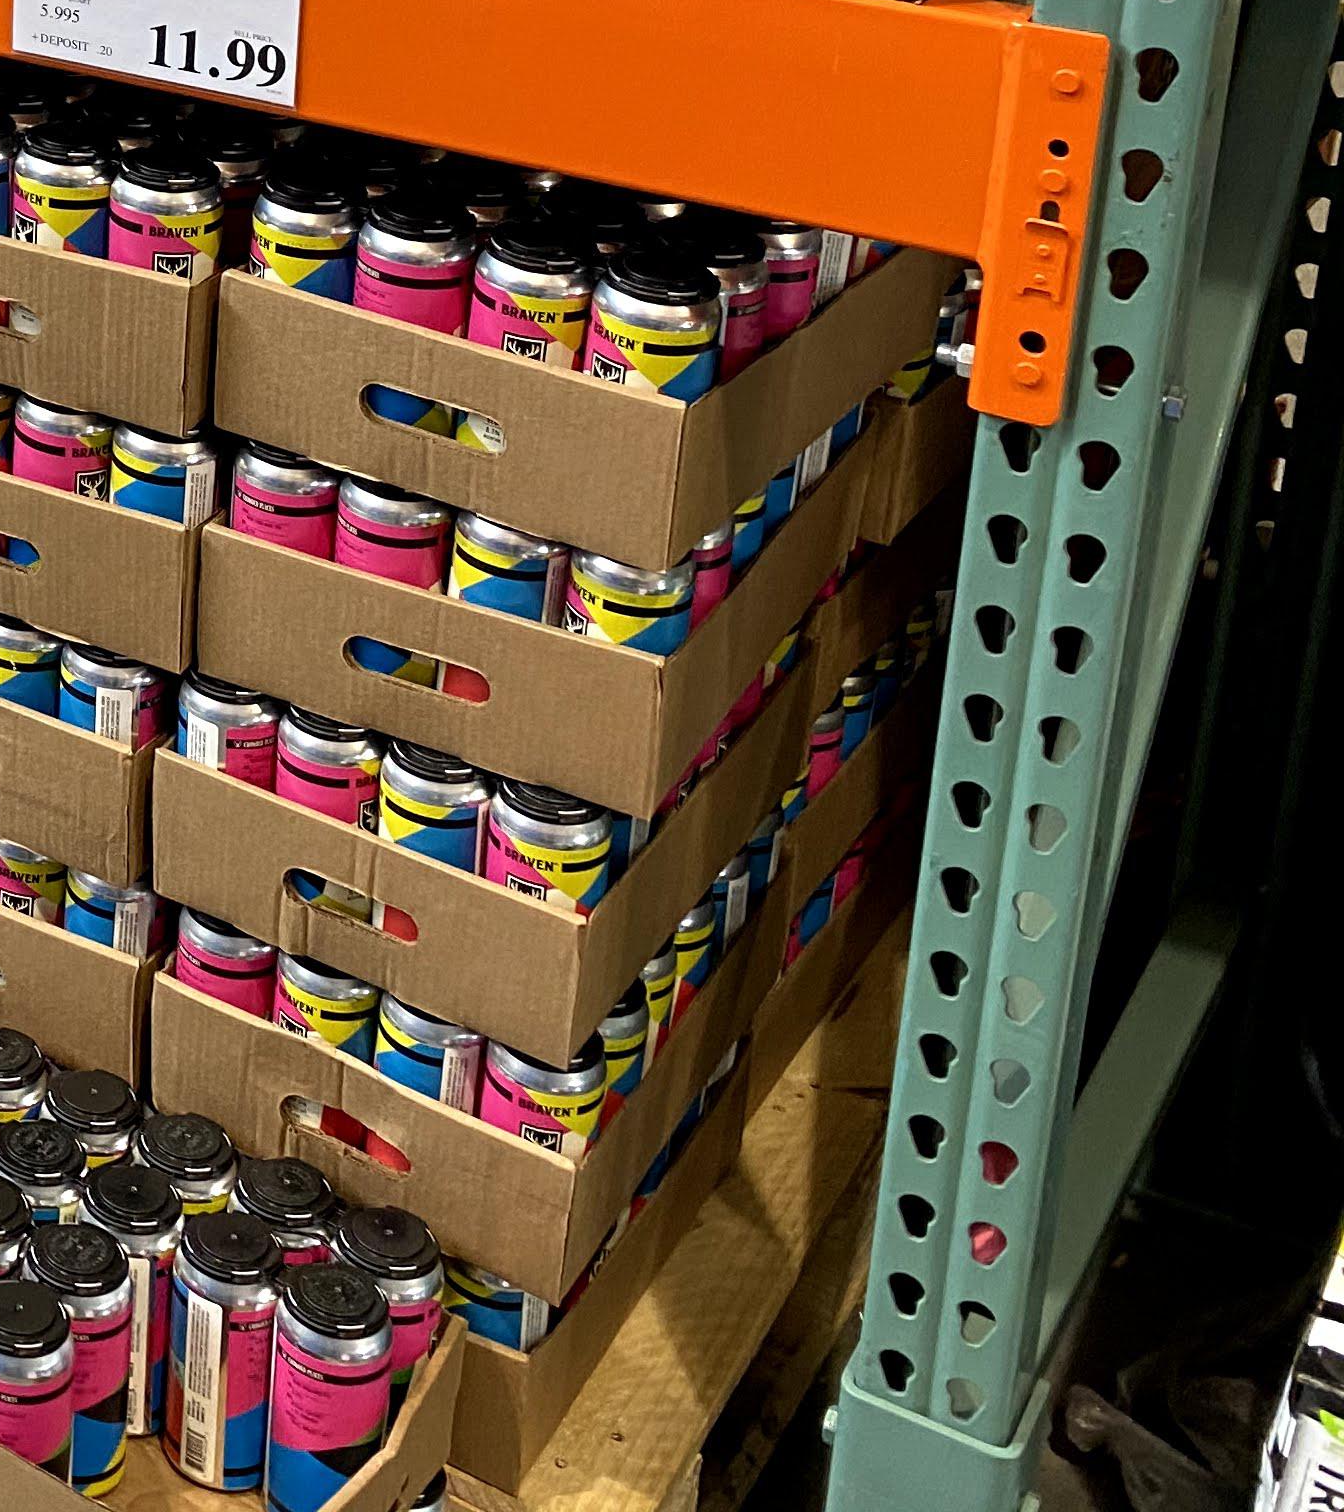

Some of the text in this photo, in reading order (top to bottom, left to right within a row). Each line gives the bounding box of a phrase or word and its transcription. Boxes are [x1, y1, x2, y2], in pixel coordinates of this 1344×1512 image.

[40, 4, 80, 23] 5.995
[148, 25, 286, 87] 11.99
[149, 225, 200, 238] BRAVEN
[501, 304, 560, 324] BRAVEN
[594, 323, 640, 351] BRAVEN
[504, 847, 558, 872] BRAVEN
[518, 1099, 574, 1119] BRAVEN
